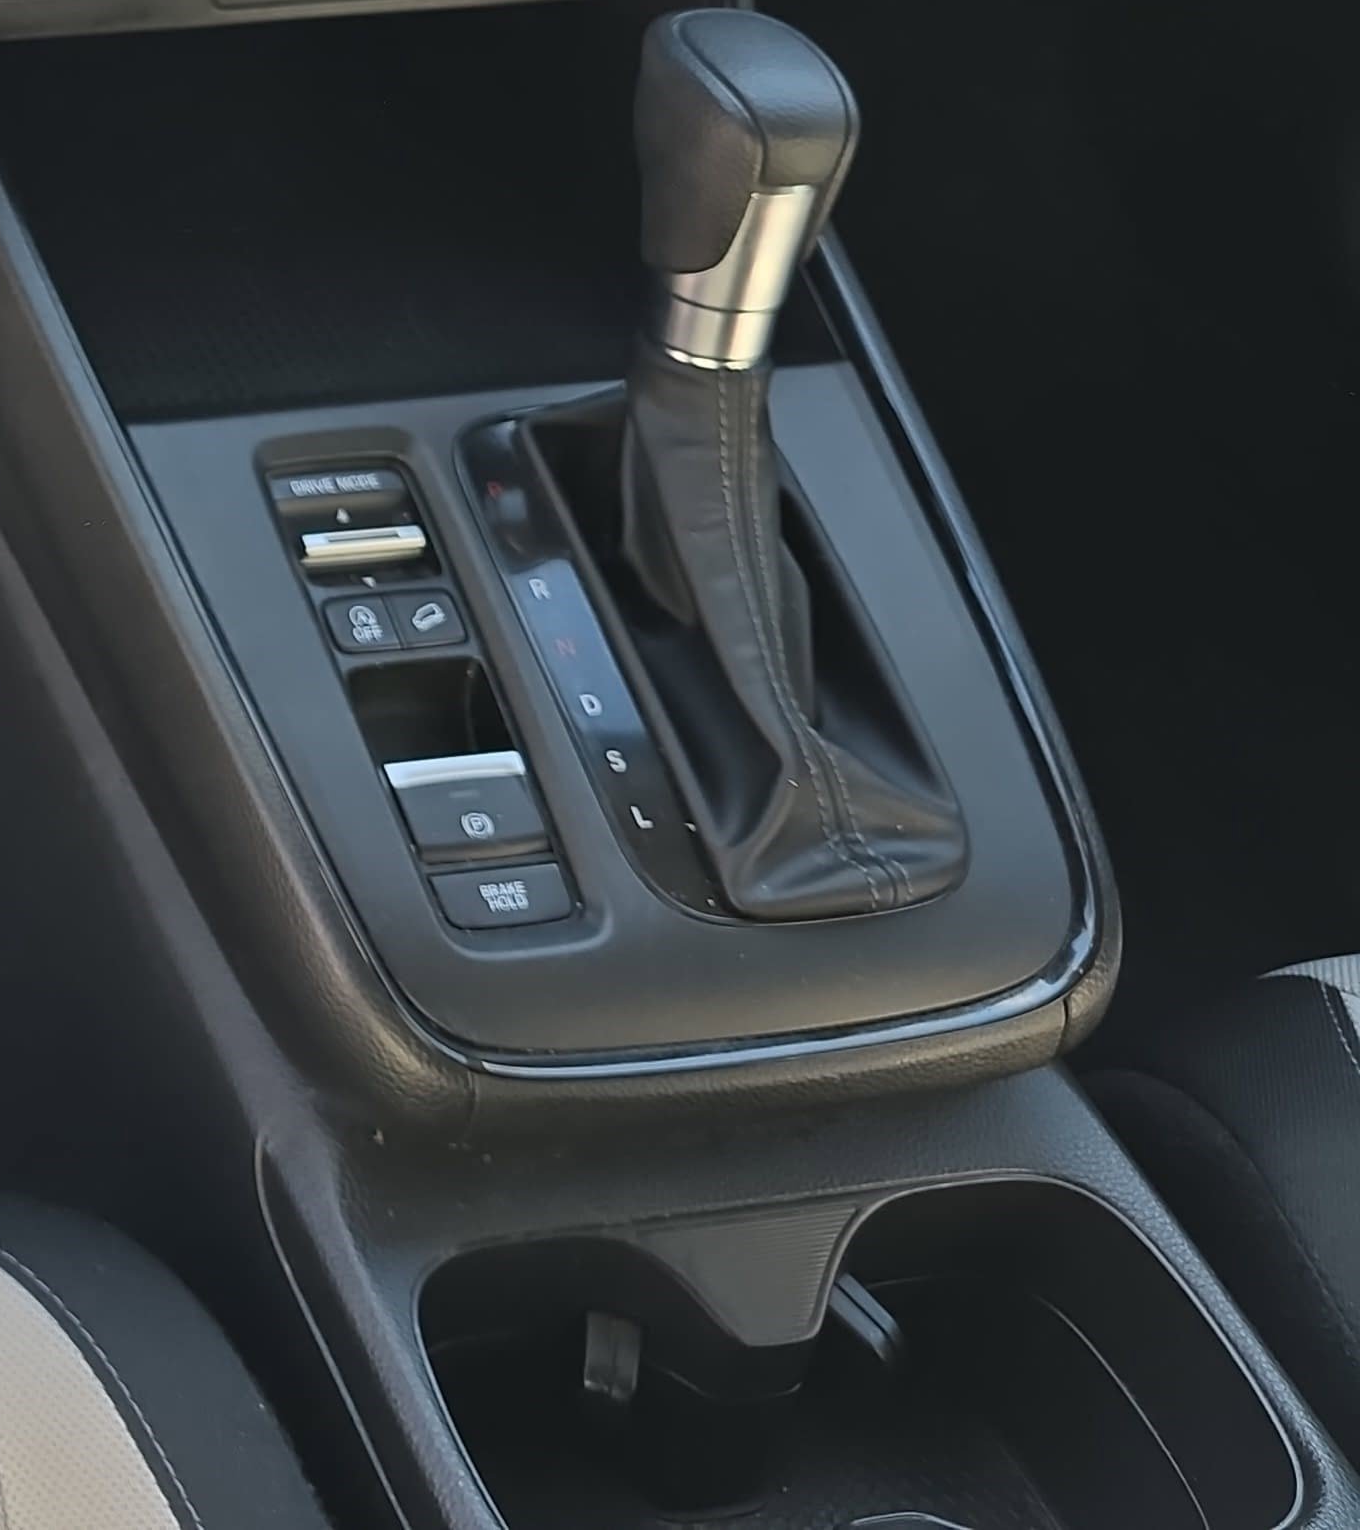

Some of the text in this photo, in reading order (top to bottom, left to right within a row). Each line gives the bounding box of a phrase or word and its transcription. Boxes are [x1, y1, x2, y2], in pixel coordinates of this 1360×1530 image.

[290, 472, 382, 496] DRIVE MODE
[528, 577, 552, 601] R
[352, 624, 385, 643] OFF
[579, 694, 604, 718] D
[605, 749, 628, 774] S
[630, 805, 654, 830] L
[479, 879, 527, 900] BRAKE
[486, 892, 530, 913] HOLD
